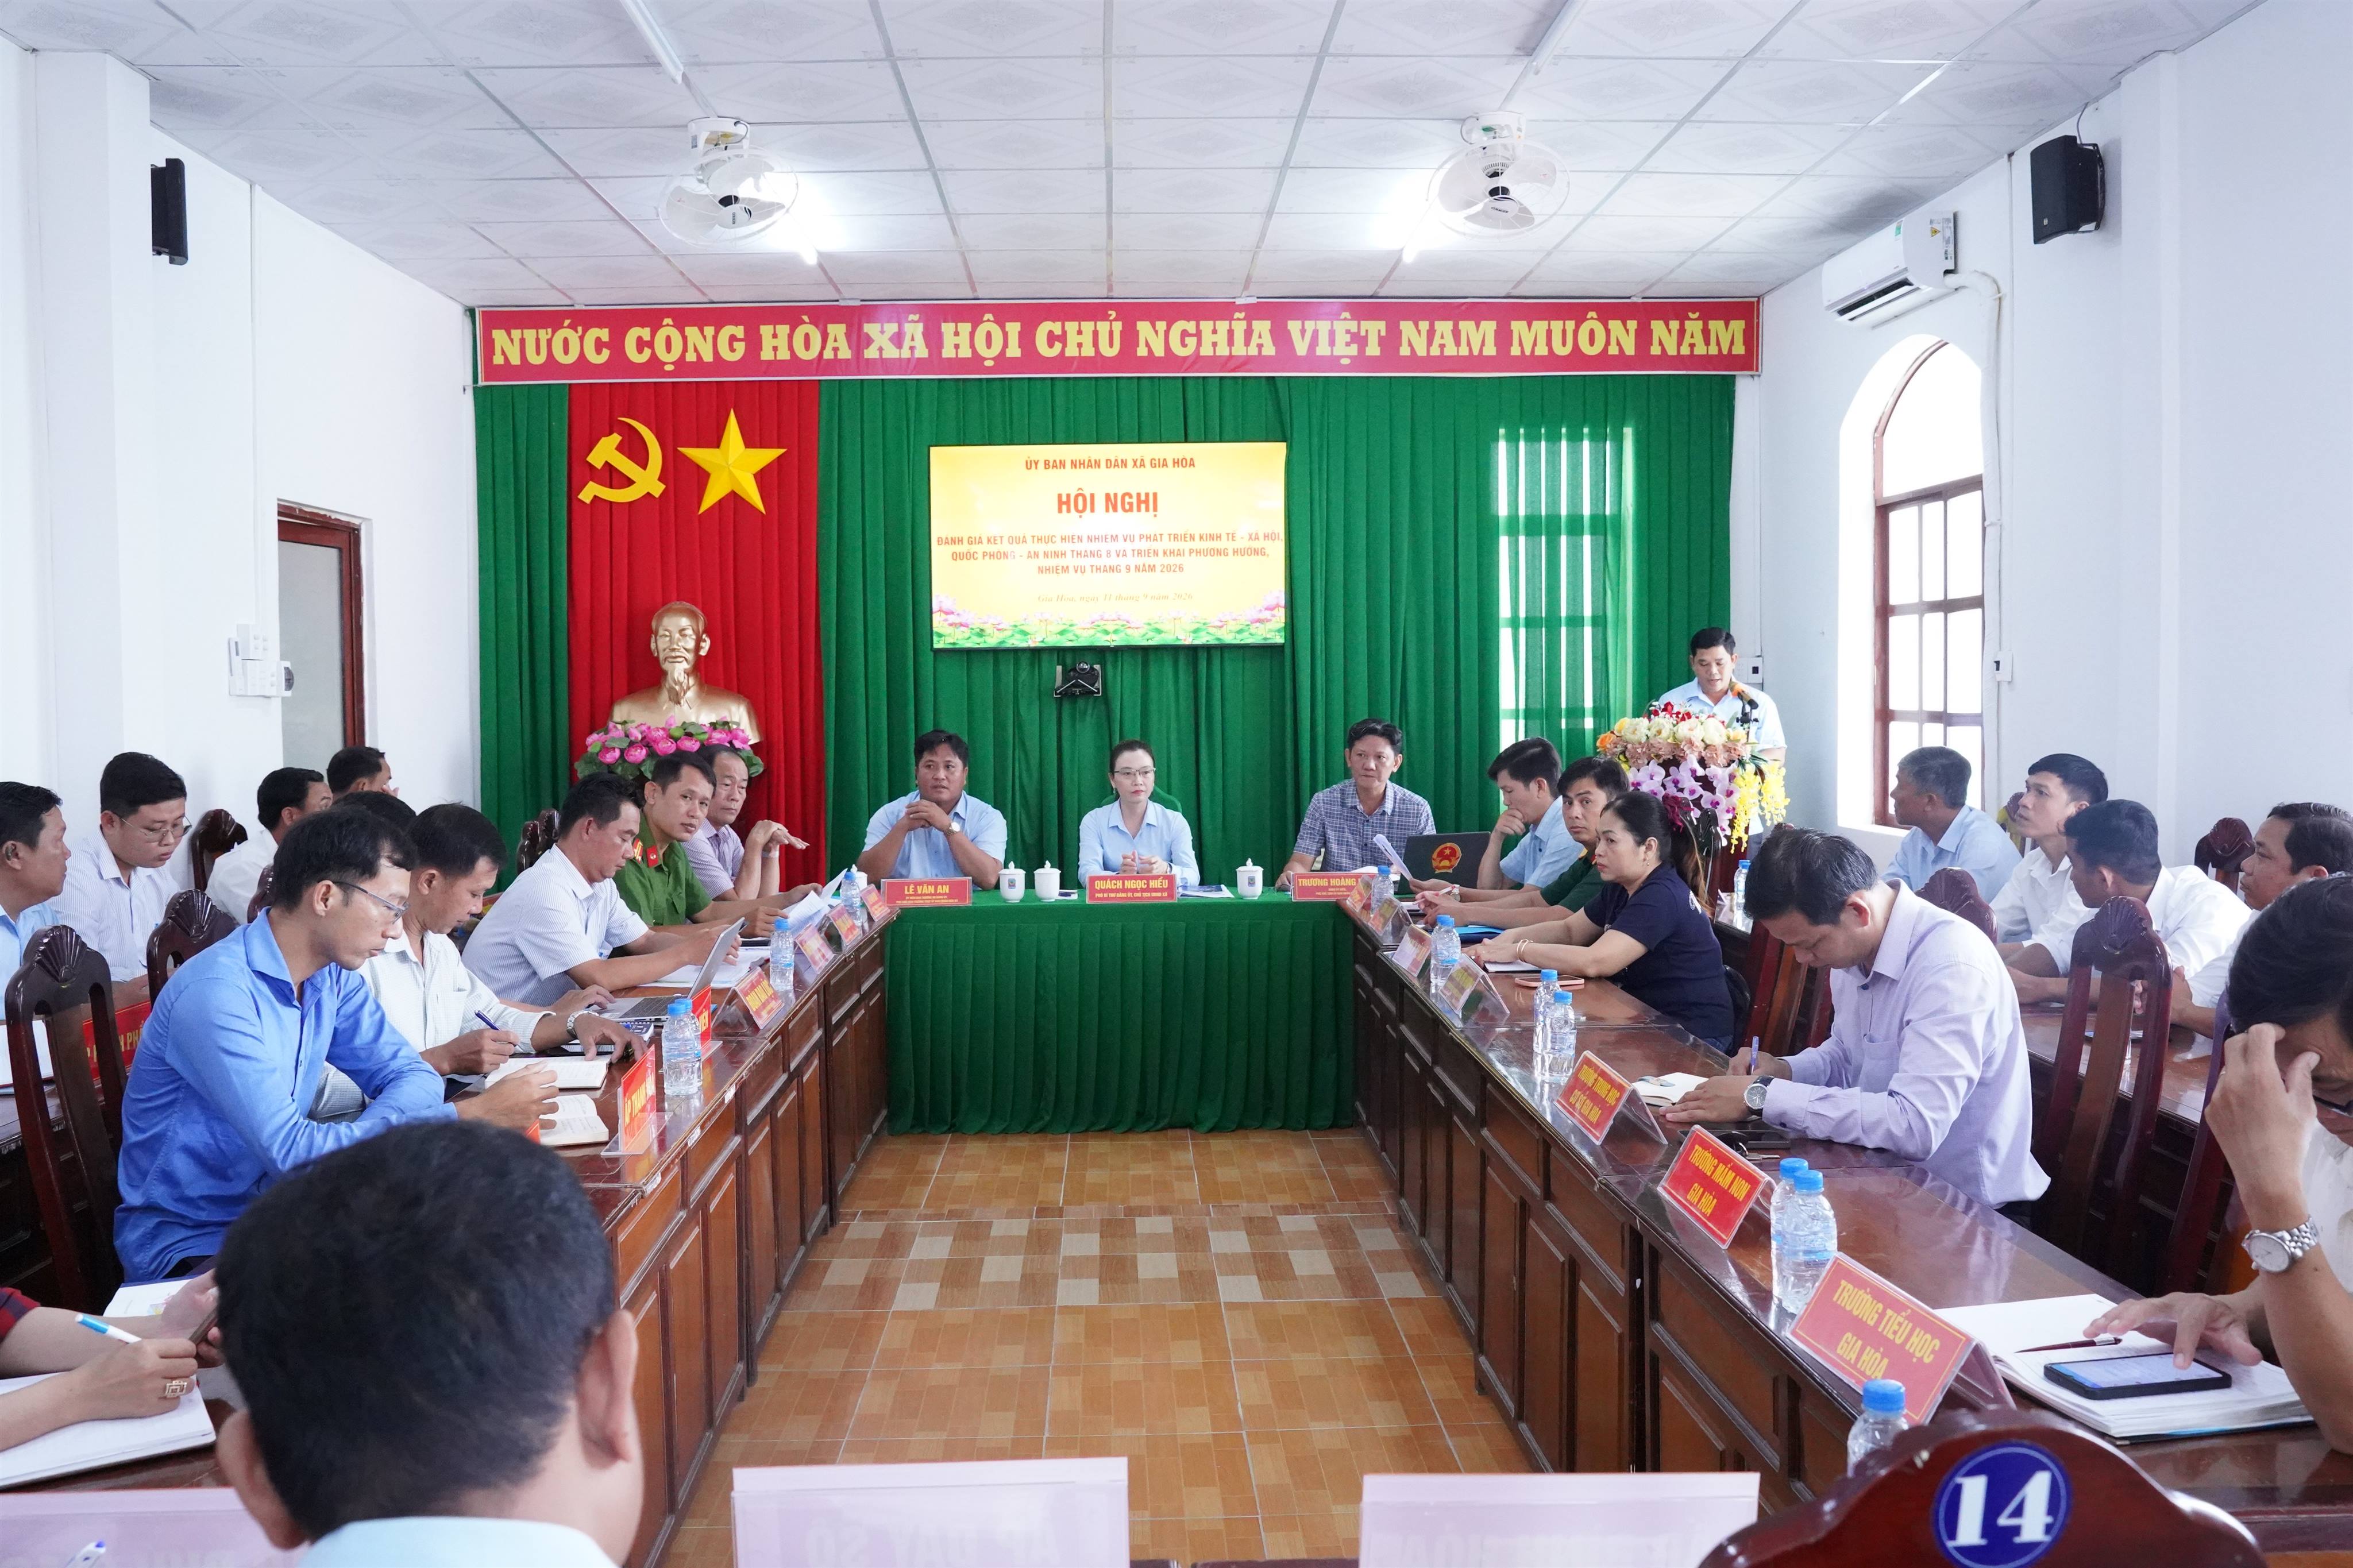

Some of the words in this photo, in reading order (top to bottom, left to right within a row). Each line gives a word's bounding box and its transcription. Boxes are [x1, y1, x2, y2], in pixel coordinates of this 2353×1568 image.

[492, 319, 610, 365] NƯỚC
[624, 318, 745, 371] CỘNG
[760, 316, 851, 361] HÒA
[863, 315, 928, 359] XÃ
[942, 314, 1020, 366] HỘI
[1035, 311, 1121, 358] CHỦ
[1136, 311, 1275, 357] NGHĨA
[1287, 312, 1386, 365] VIỆT
[1400, 320, 1496, 356] NAM
[1511, 312, 1637, 356] MUÔN
[1651, 311, 1746, 355] NĂM
[1025, 456, 1039, 470] ỦY
[1043, 458, 1066, 470] BAN
[1070, 456, 1101, 470] NHÂN
[1105, 455, 1128, 469] DÂN
[1132, 455, 1146, 469] XÃ
[1150, 457, 1168, 469] GIA
[1172, 454, 1195, 469] HÒA
[1057, 488, 1096, 519] HỘI
[1105, 492, 1158, 518] NGHỊ
[1199, 533, 1222, 542] KINH
[1027, 550, 1039, 559] AN
[1043, 550, 1067, 559] NINH
[1106, 550, 1111, 558] 8
[1163, 548, 1185, 557] KHAI
[1189, 547, 1229, 557] PHƯƠNG
[1125, 565, 1131, 573] 9
[1160, 563, 1184, 573] 2026
[1143, 592, 1148, 601] 9
[904, 883, 915, 894] LÊ
[917, 883, 935, 894] VĂN
[937, 885, 950, 894] AN
[1095, 878, 1123, 890] QUÁCH
[1124, 879, 1147, 890] NGỌC
[1298, 878, 1328, 887] TRƯƠNG
[1330, 876, 1356, 886] HOÀNG
[1592, 1076, 1612, 1099] TRUNG
[1605, 1087, 1620, 1106] HỌC
[1688, 1144, 1718, 1176] TRƯỜNG
[1711, 1163, 1736, 1190] MẦM
[1729, 1176, 1751, 1202] NON
[1687, 1183, 1704, 1205] GIA
[1697, 1191, 1718, 1217] HÒA
[1833, 1279, 1884, 1327] TRƯỜNG
[1878, 1308, 1912, 1345] TIỂU
[1905, 1328, 1941, 1364] HỌC
[1837, 1332, 1862, 1364] GIA
[1857, 1347, 1889, 1380] HÒA
[1947, 1469, 2054, 1547] 14
